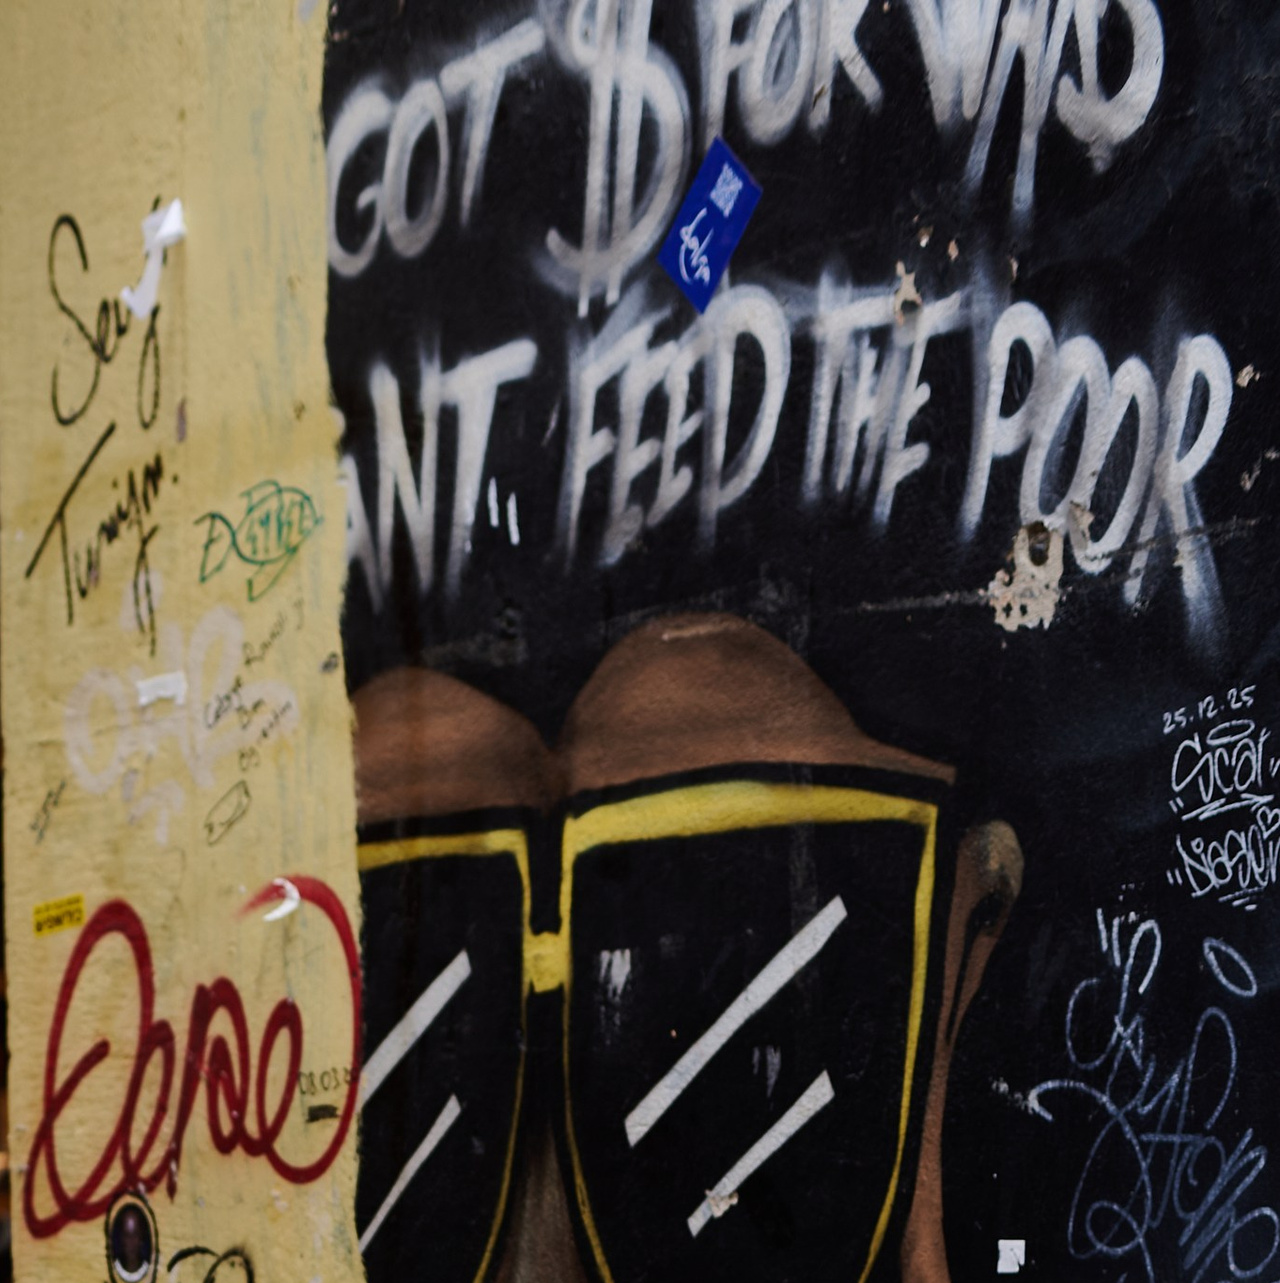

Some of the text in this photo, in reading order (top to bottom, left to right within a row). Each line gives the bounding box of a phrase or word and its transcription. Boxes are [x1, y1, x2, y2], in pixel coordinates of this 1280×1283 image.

[325, 17, 544, 278] GOT
[560, 283, 791, 565] FEED
[802, 288, 961, 530] THE
[958, 300, 1232, 640] POOR
[1163, 684, 1257, 735] 25.12.25
